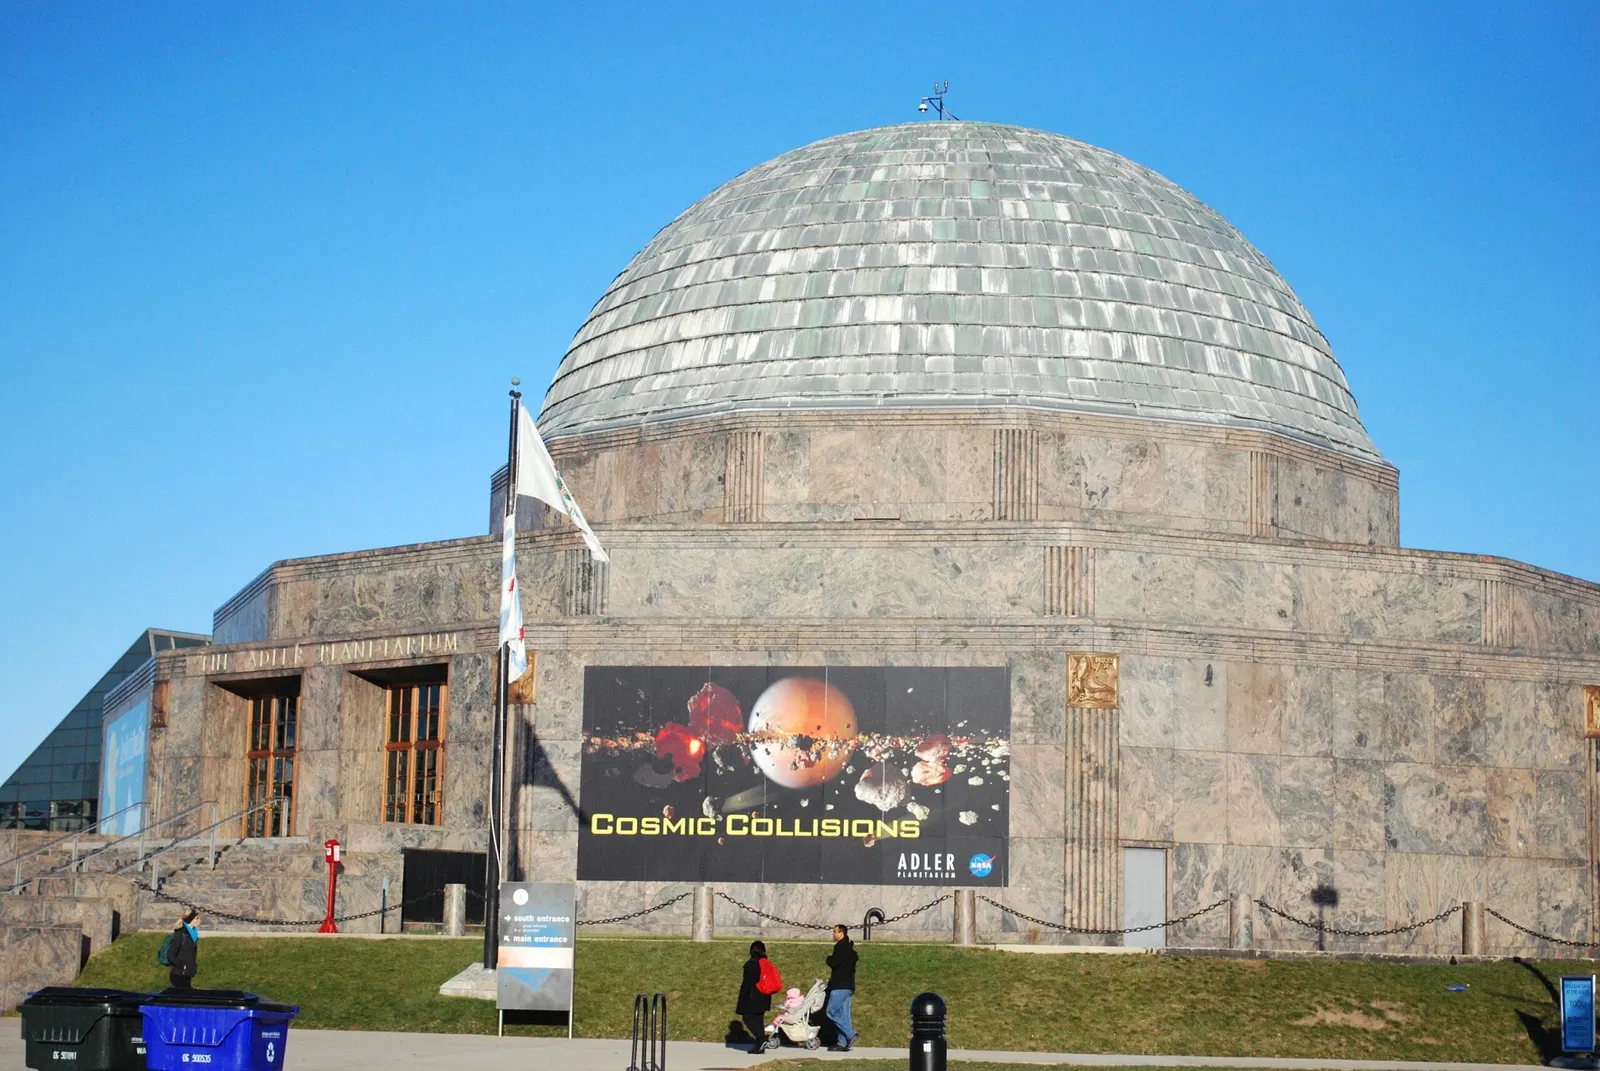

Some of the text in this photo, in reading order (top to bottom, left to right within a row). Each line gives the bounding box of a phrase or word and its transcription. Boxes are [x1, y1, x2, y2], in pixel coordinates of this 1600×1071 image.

[248, 643, 303, 668] ADLER
[320, 633, 458, 662] PLANETARIUM
[590, 813, 921, 838] COSMIC COLLISIONS
[897, 852, 955, 871] ADLER
[513, 914, 570, 923] south entrance
[534, 935, 568, 943] entrance
